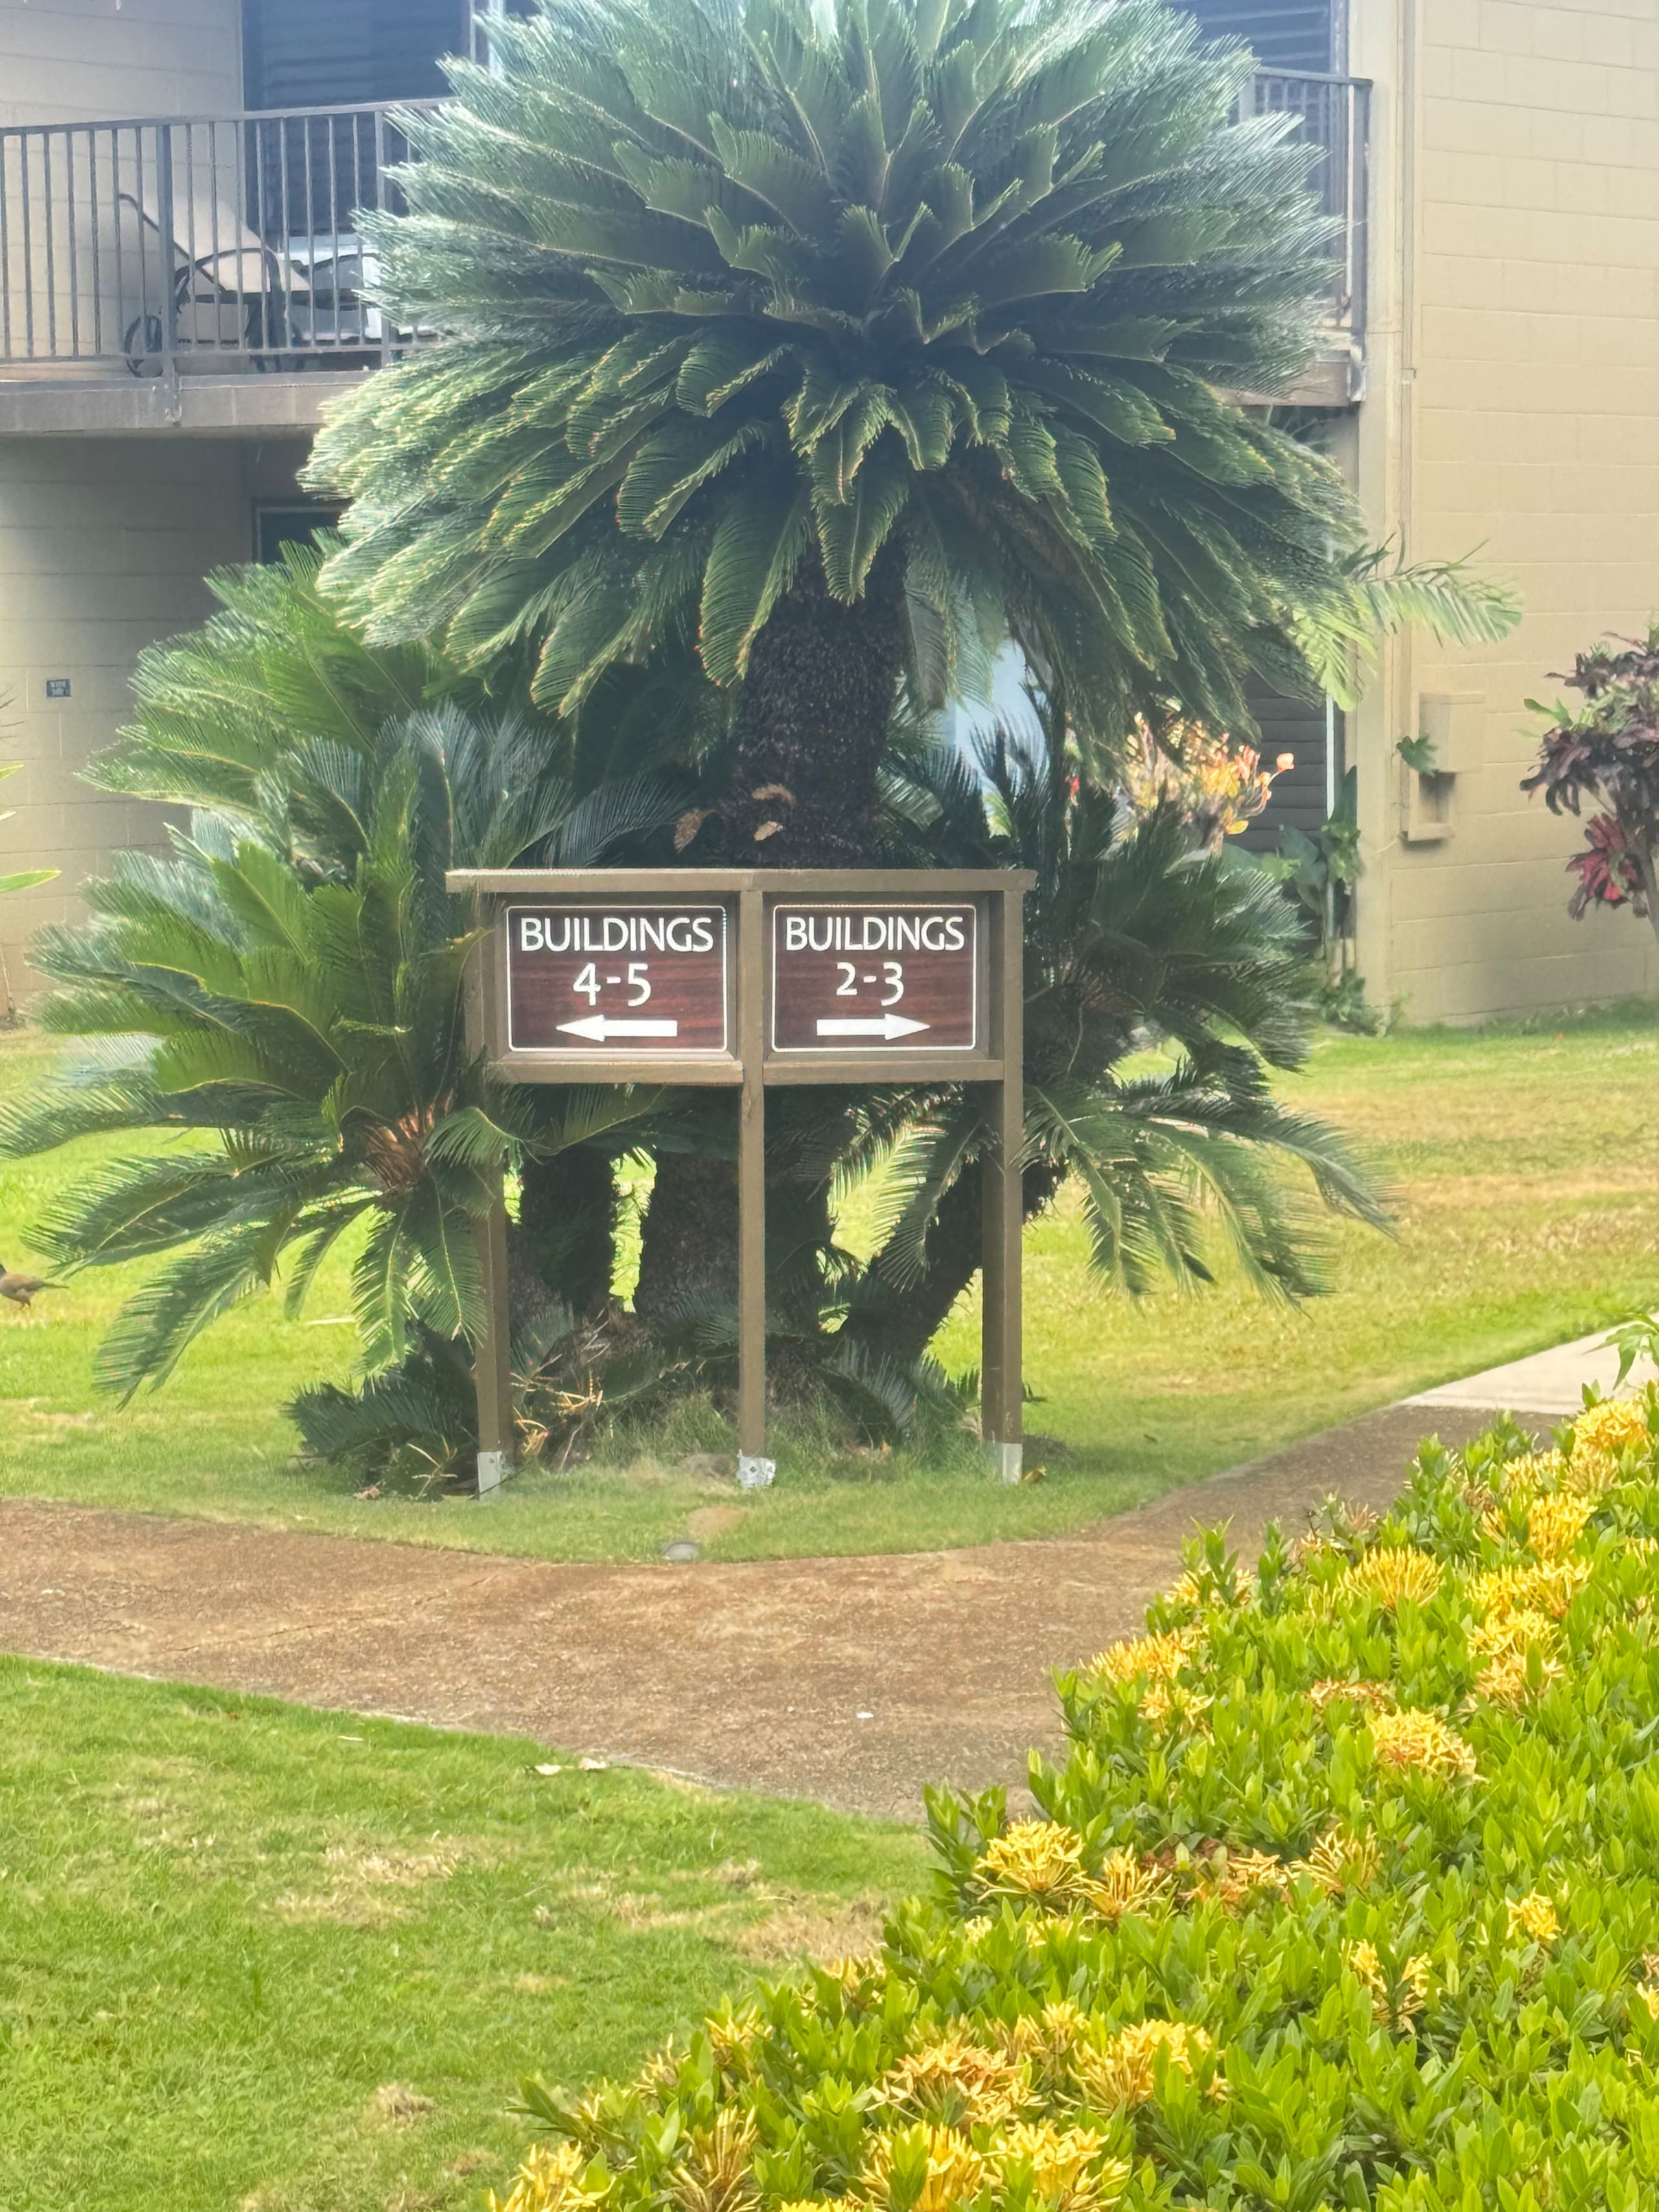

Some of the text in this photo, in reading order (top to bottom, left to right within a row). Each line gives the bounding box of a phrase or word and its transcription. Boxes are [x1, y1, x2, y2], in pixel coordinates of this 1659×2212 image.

[521, 916, 714, 952] BUILDINGS
[785, 916, 965, 951] BUILDINGS
[572, 962, 651, 1007] 4-5
[835, 962, 905, 1006] 2-3
